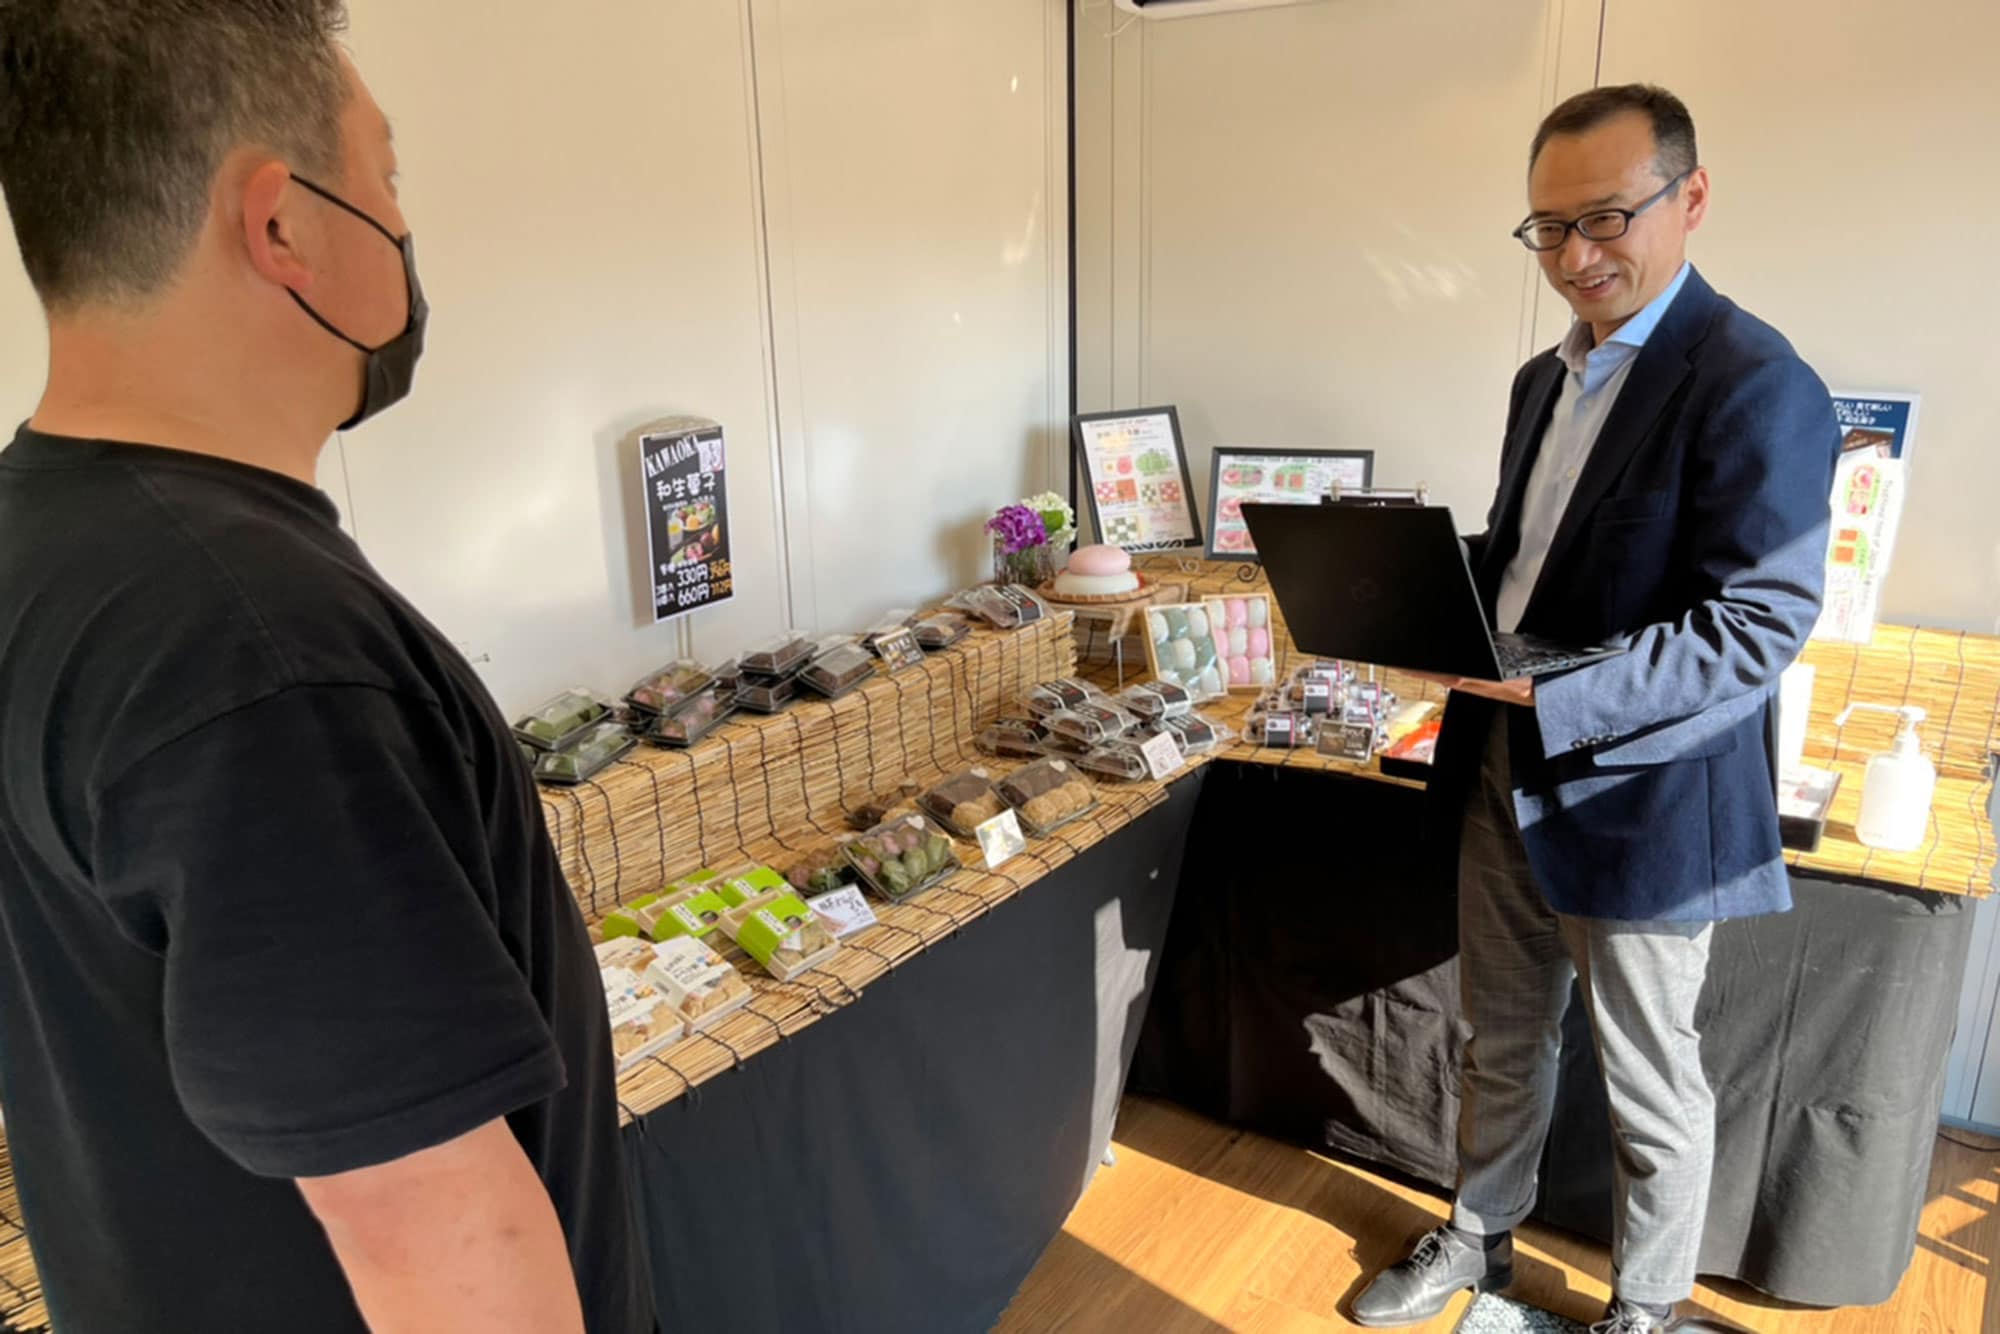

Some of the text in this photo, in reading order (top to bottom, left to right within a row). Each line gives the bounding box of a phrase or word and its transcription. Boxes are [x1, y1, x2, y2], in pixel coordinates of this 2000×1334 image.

[656, 472, 716, 502] 和生菓子
[677, 563, 708, 587] 330円
[678, 582, 709, 607] 660円
